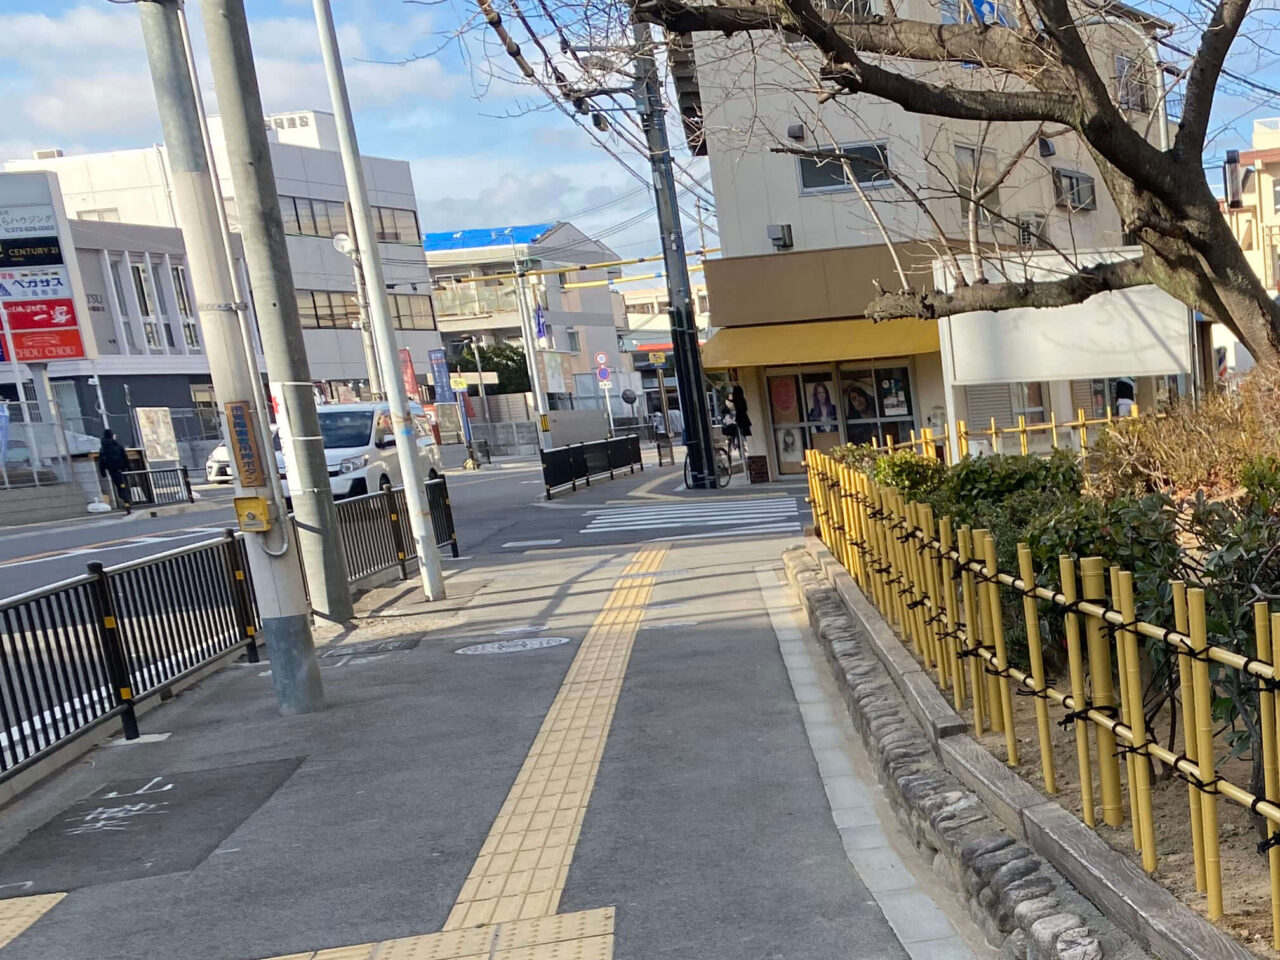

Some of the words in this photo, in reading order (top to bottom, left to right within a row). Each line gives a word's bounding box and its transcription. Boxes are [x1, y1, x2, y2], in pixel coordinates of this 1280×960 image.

[8, 247, 48, 256] CENTURY
[12, 277, 64, 289] ペガサス
[45, 346, 76, 356] CHOU
